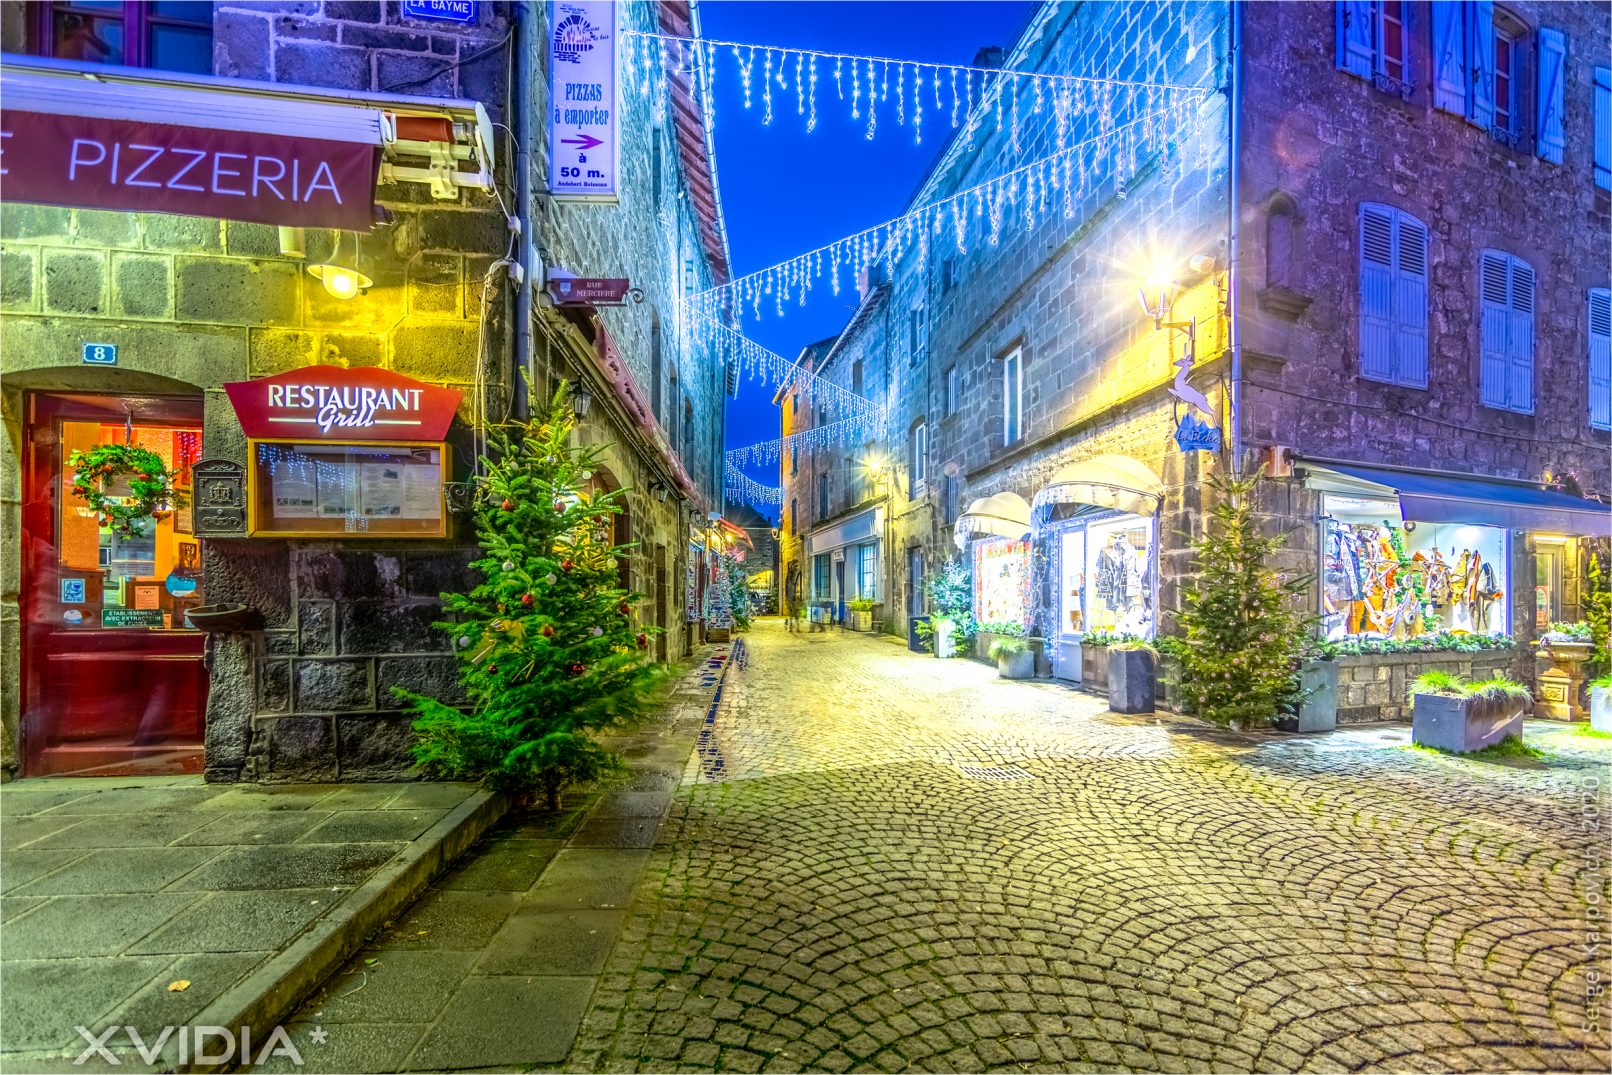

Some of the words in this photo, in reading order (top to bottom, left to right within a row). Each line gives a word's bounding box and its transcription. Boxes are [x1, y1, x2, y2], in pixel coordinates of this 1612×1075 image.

[410, 0, 425, 8] LA
[431, 0, 469, 13] GAYME
[565, 82, 602, 102] PIZZAS
[554, 104, 561, 124] à
[564, 106, 609, 130] emporter
[578, 152, 587, 163] à
[68, 138, 343, 205] PIZZERIA
[560, 166, 581, 178] 50
[587, 169, 605, 178] m.
[93, 346, 106, 360] 8
[267, 384, 424, 411] RESTAURANT
[316, 403, 376, 433] Grill
